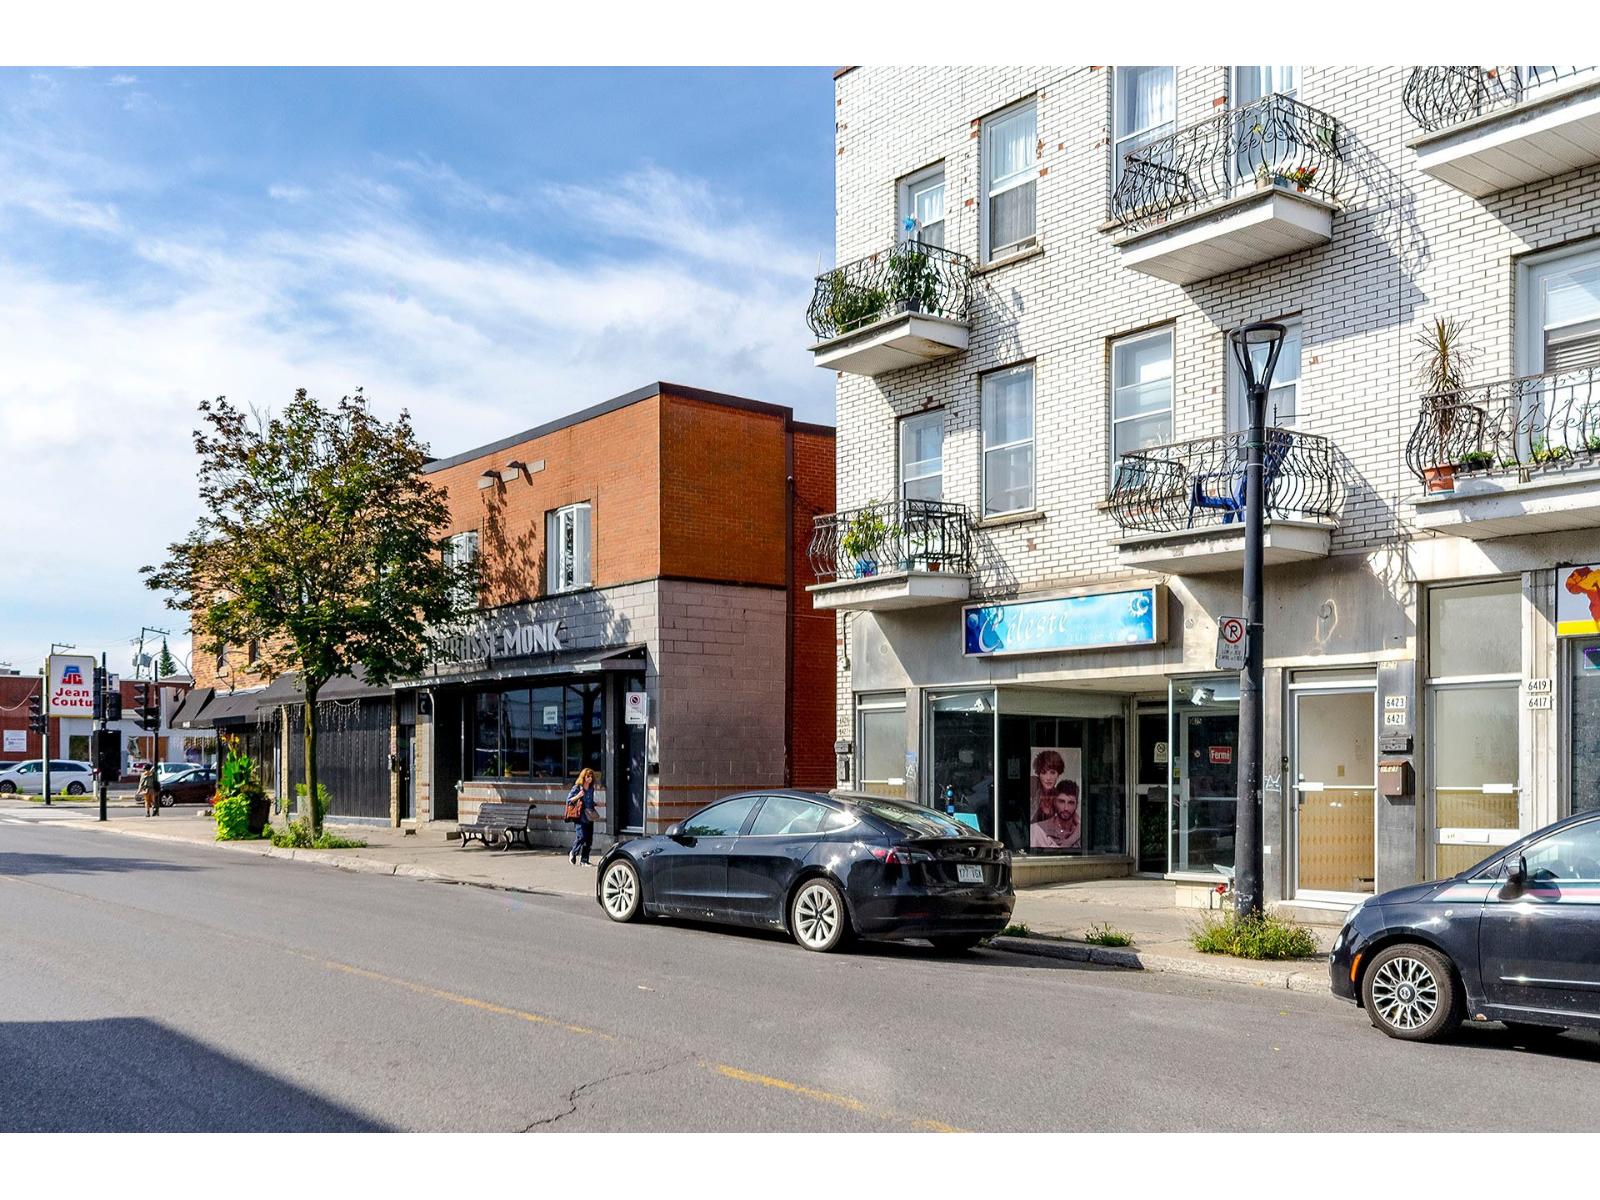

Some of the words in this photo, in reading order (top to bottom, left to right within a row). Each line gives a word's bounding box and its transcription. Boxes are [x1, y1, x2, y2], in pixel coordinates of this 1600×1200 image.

[500, 620, 562, 656] MONK
[1528, 680, 1547, 691] 6419
[55, 687, 90, 697] Jean
[51, 697, 93, 707] Coutu
[1386, 697, 1405, 708] 6423
[1528, 697, 1547, 708] 6417
[1386, 714, 1405, 725] 6421
[1210, 749, 1231, 760] Fermé
